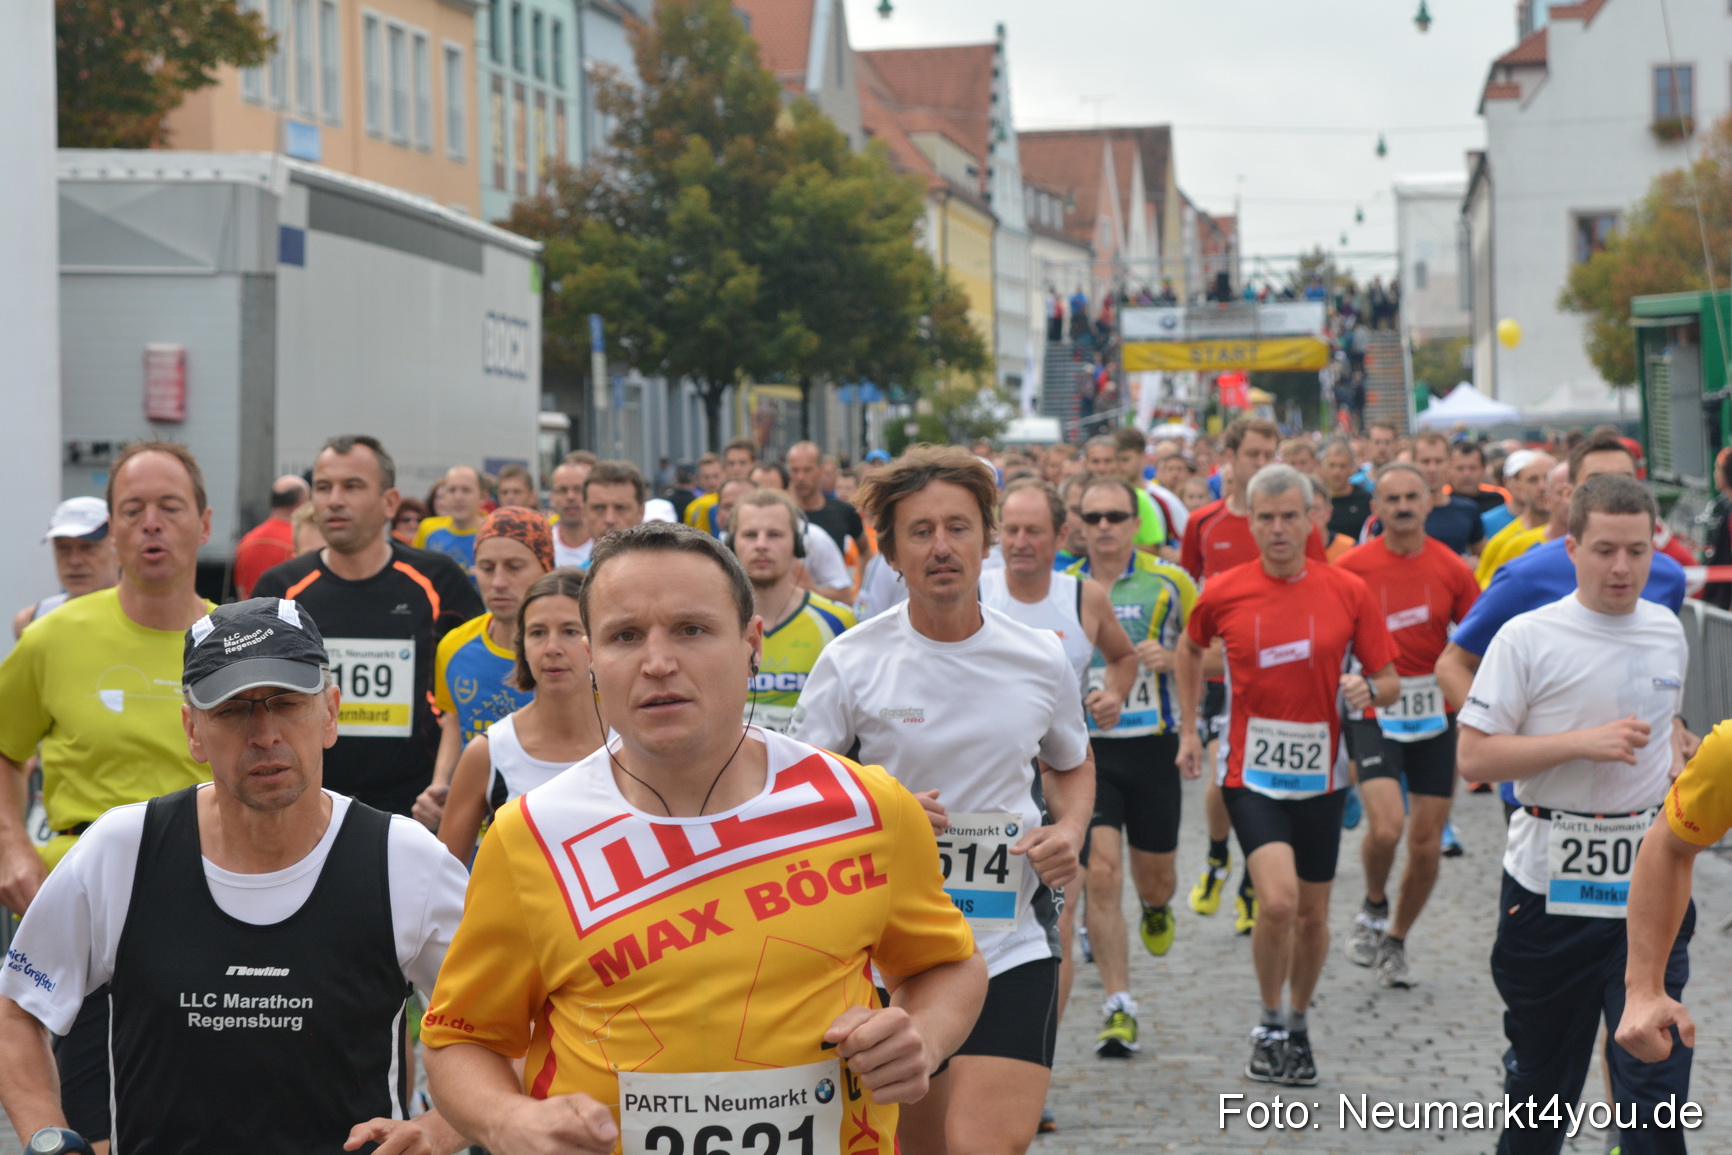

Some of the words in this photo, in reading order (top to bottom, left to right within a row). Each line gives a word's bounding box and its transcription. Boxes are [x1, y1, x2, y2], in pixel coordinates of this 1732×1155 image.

[1190, 346, 1259, 364] START
[223, 632, 241, 643] LLC
[223, 629, 263, 649] Marathon
[224, 628, 275, 655] Regensburg
[329, 662, 393, 699] 169
[338, 708, 391, 722] ernhard
[1253, 738, 1323, 771] 2452
[1553, 820, 1592, 834] PARTL
[1593, 822, 1646, 834] Neumarkt
[936, 841, 1010, 884] 514
[1561, 838, 1644, 876] 250
[1579, 885, 1629, 903] Marku
[587, 898, 735, 989] MAX
[744, 853, 889, 922] BÖGL
[23, 963, 57, 993] Größte!
[179, 992, 218, 1008] LLC
[223, 993, 314, 1010] Marathon
[187, 1012, 304, 1031] Regensburg
[624, 1093, 698, 1113] PARTL
[704, 1088, 808, 1113] Neumarkt
